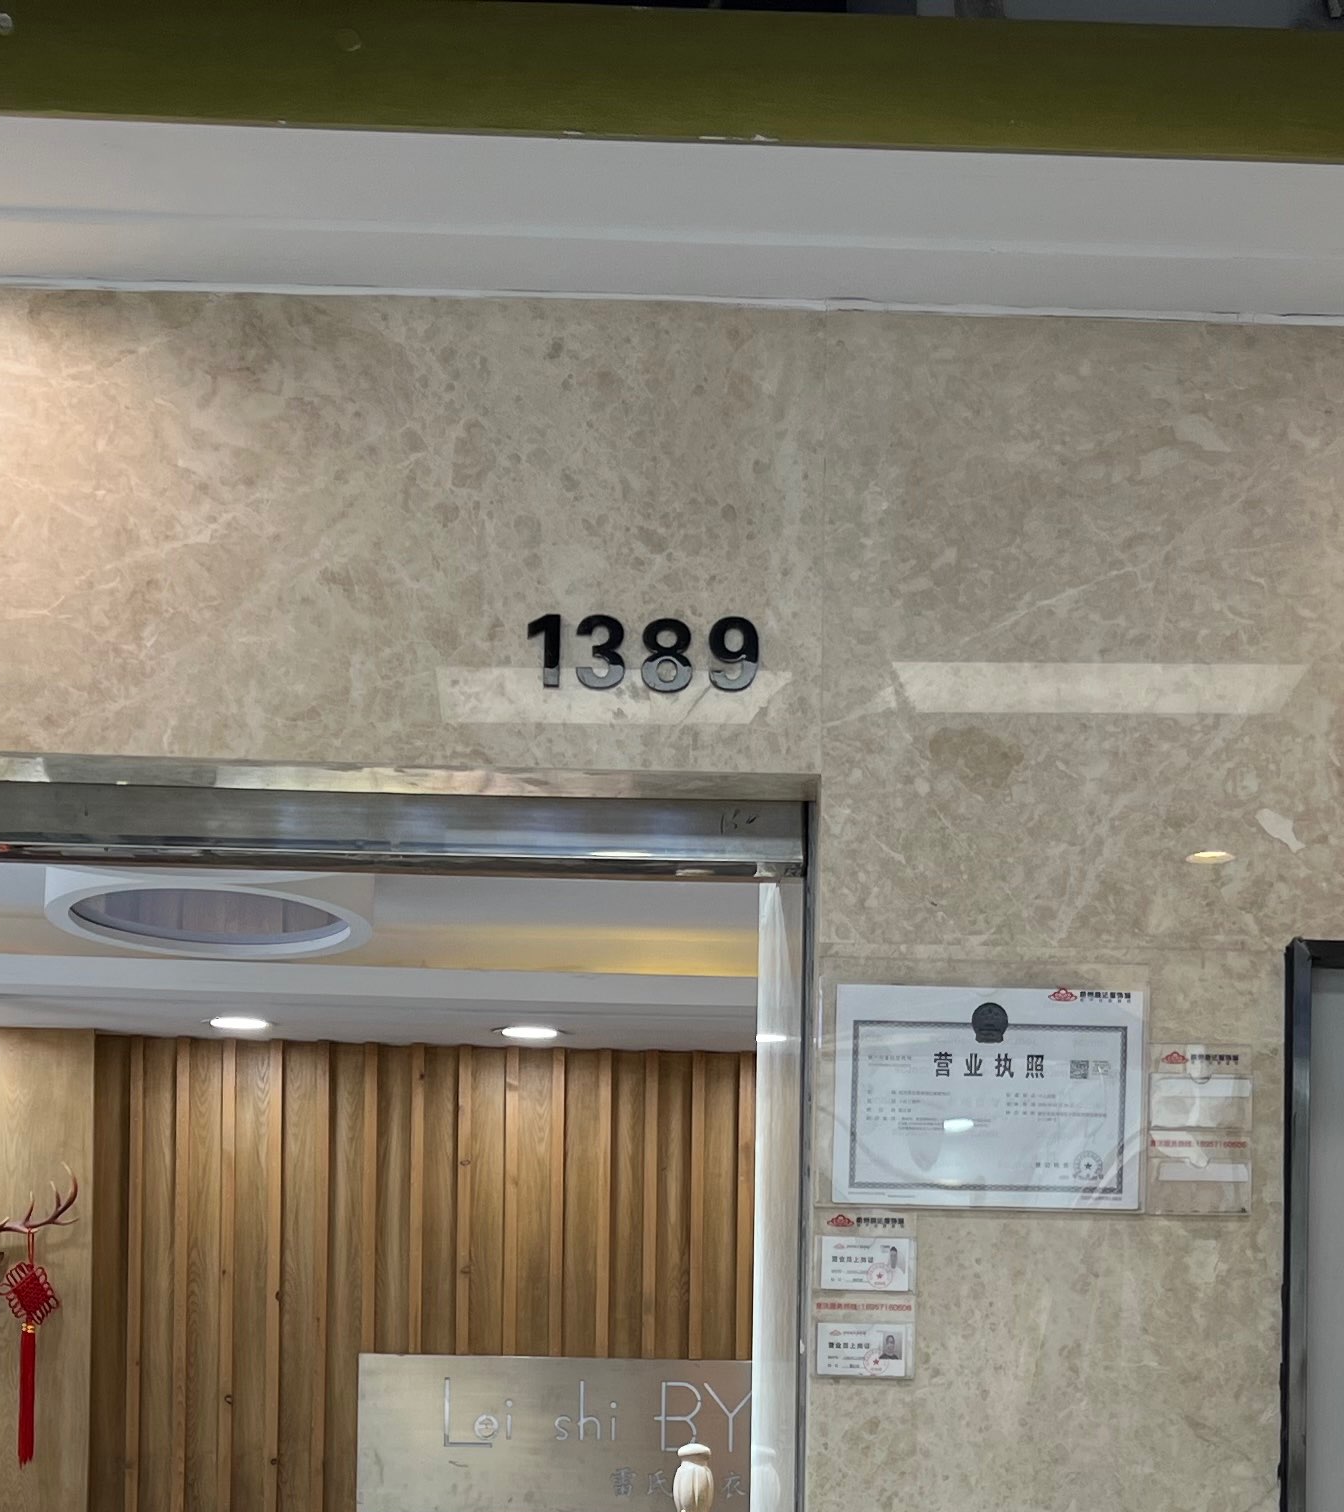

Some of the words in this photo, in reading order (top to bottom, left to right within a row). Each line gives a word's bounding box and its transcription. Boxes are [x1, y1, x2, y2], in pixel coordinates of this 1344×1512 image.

[527, 614, 759, 693] 1389
[934, 1052, 1045, 1079] 营业执照
[444, 1376, 513, 1448] Lei
[554, 1379, 618, 1441] shi
[654, 1381, 752, 1452] BY
[610, 1466, 747, 1499] 雷氏衣
